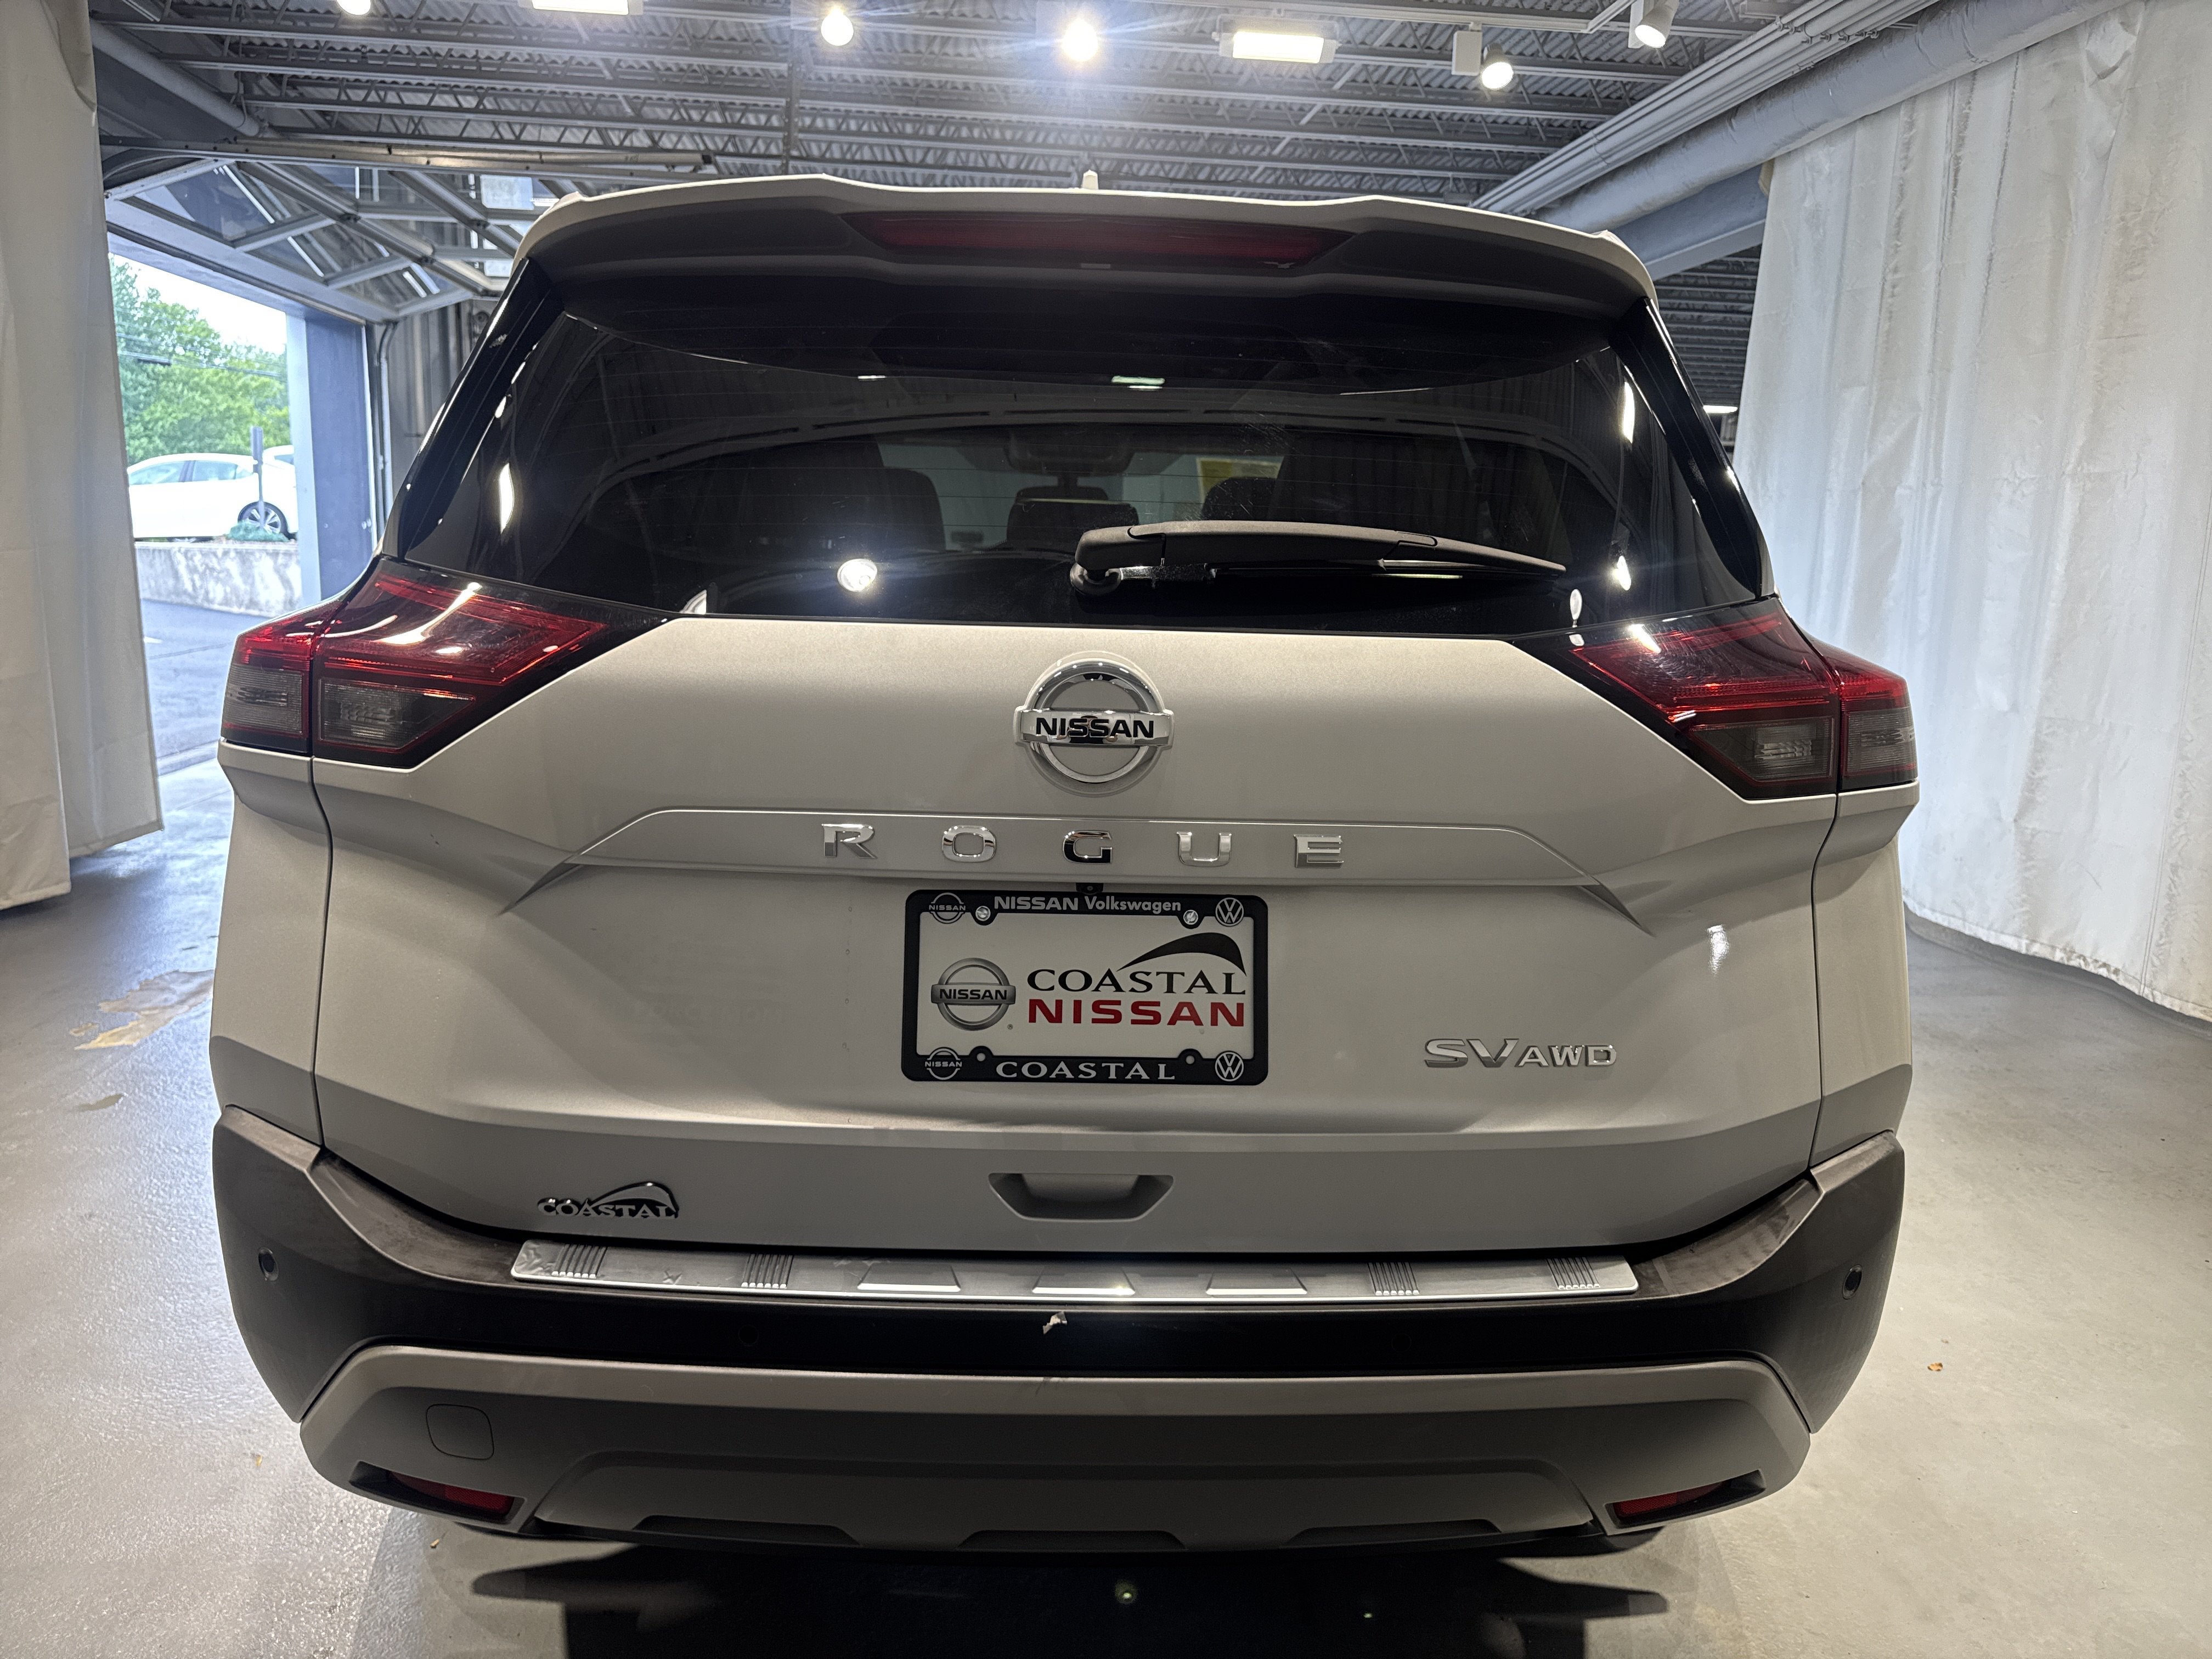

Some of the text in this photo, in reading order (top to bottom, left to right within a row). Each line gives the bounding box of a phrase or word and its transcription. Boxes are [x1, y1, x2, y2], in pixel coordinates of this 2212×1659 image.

[1035, 717, 1154, 738] NISSAN
[822, 823, 1344, 869] ROGUE
[994, 896, 1181, 914] NISSAN Volkswagen
[1027, 968, 1246, 995] COASTAL
[940, 989, 1007, 1000] NISSAN
[1028, 998, 1244, 1027] NISSAN
[1425, 1039, 1617, 1068] SV AWD
[996, 1062, 1175, 1080] COASTAL
[537, 1198, 678, 1218] COASTAL
